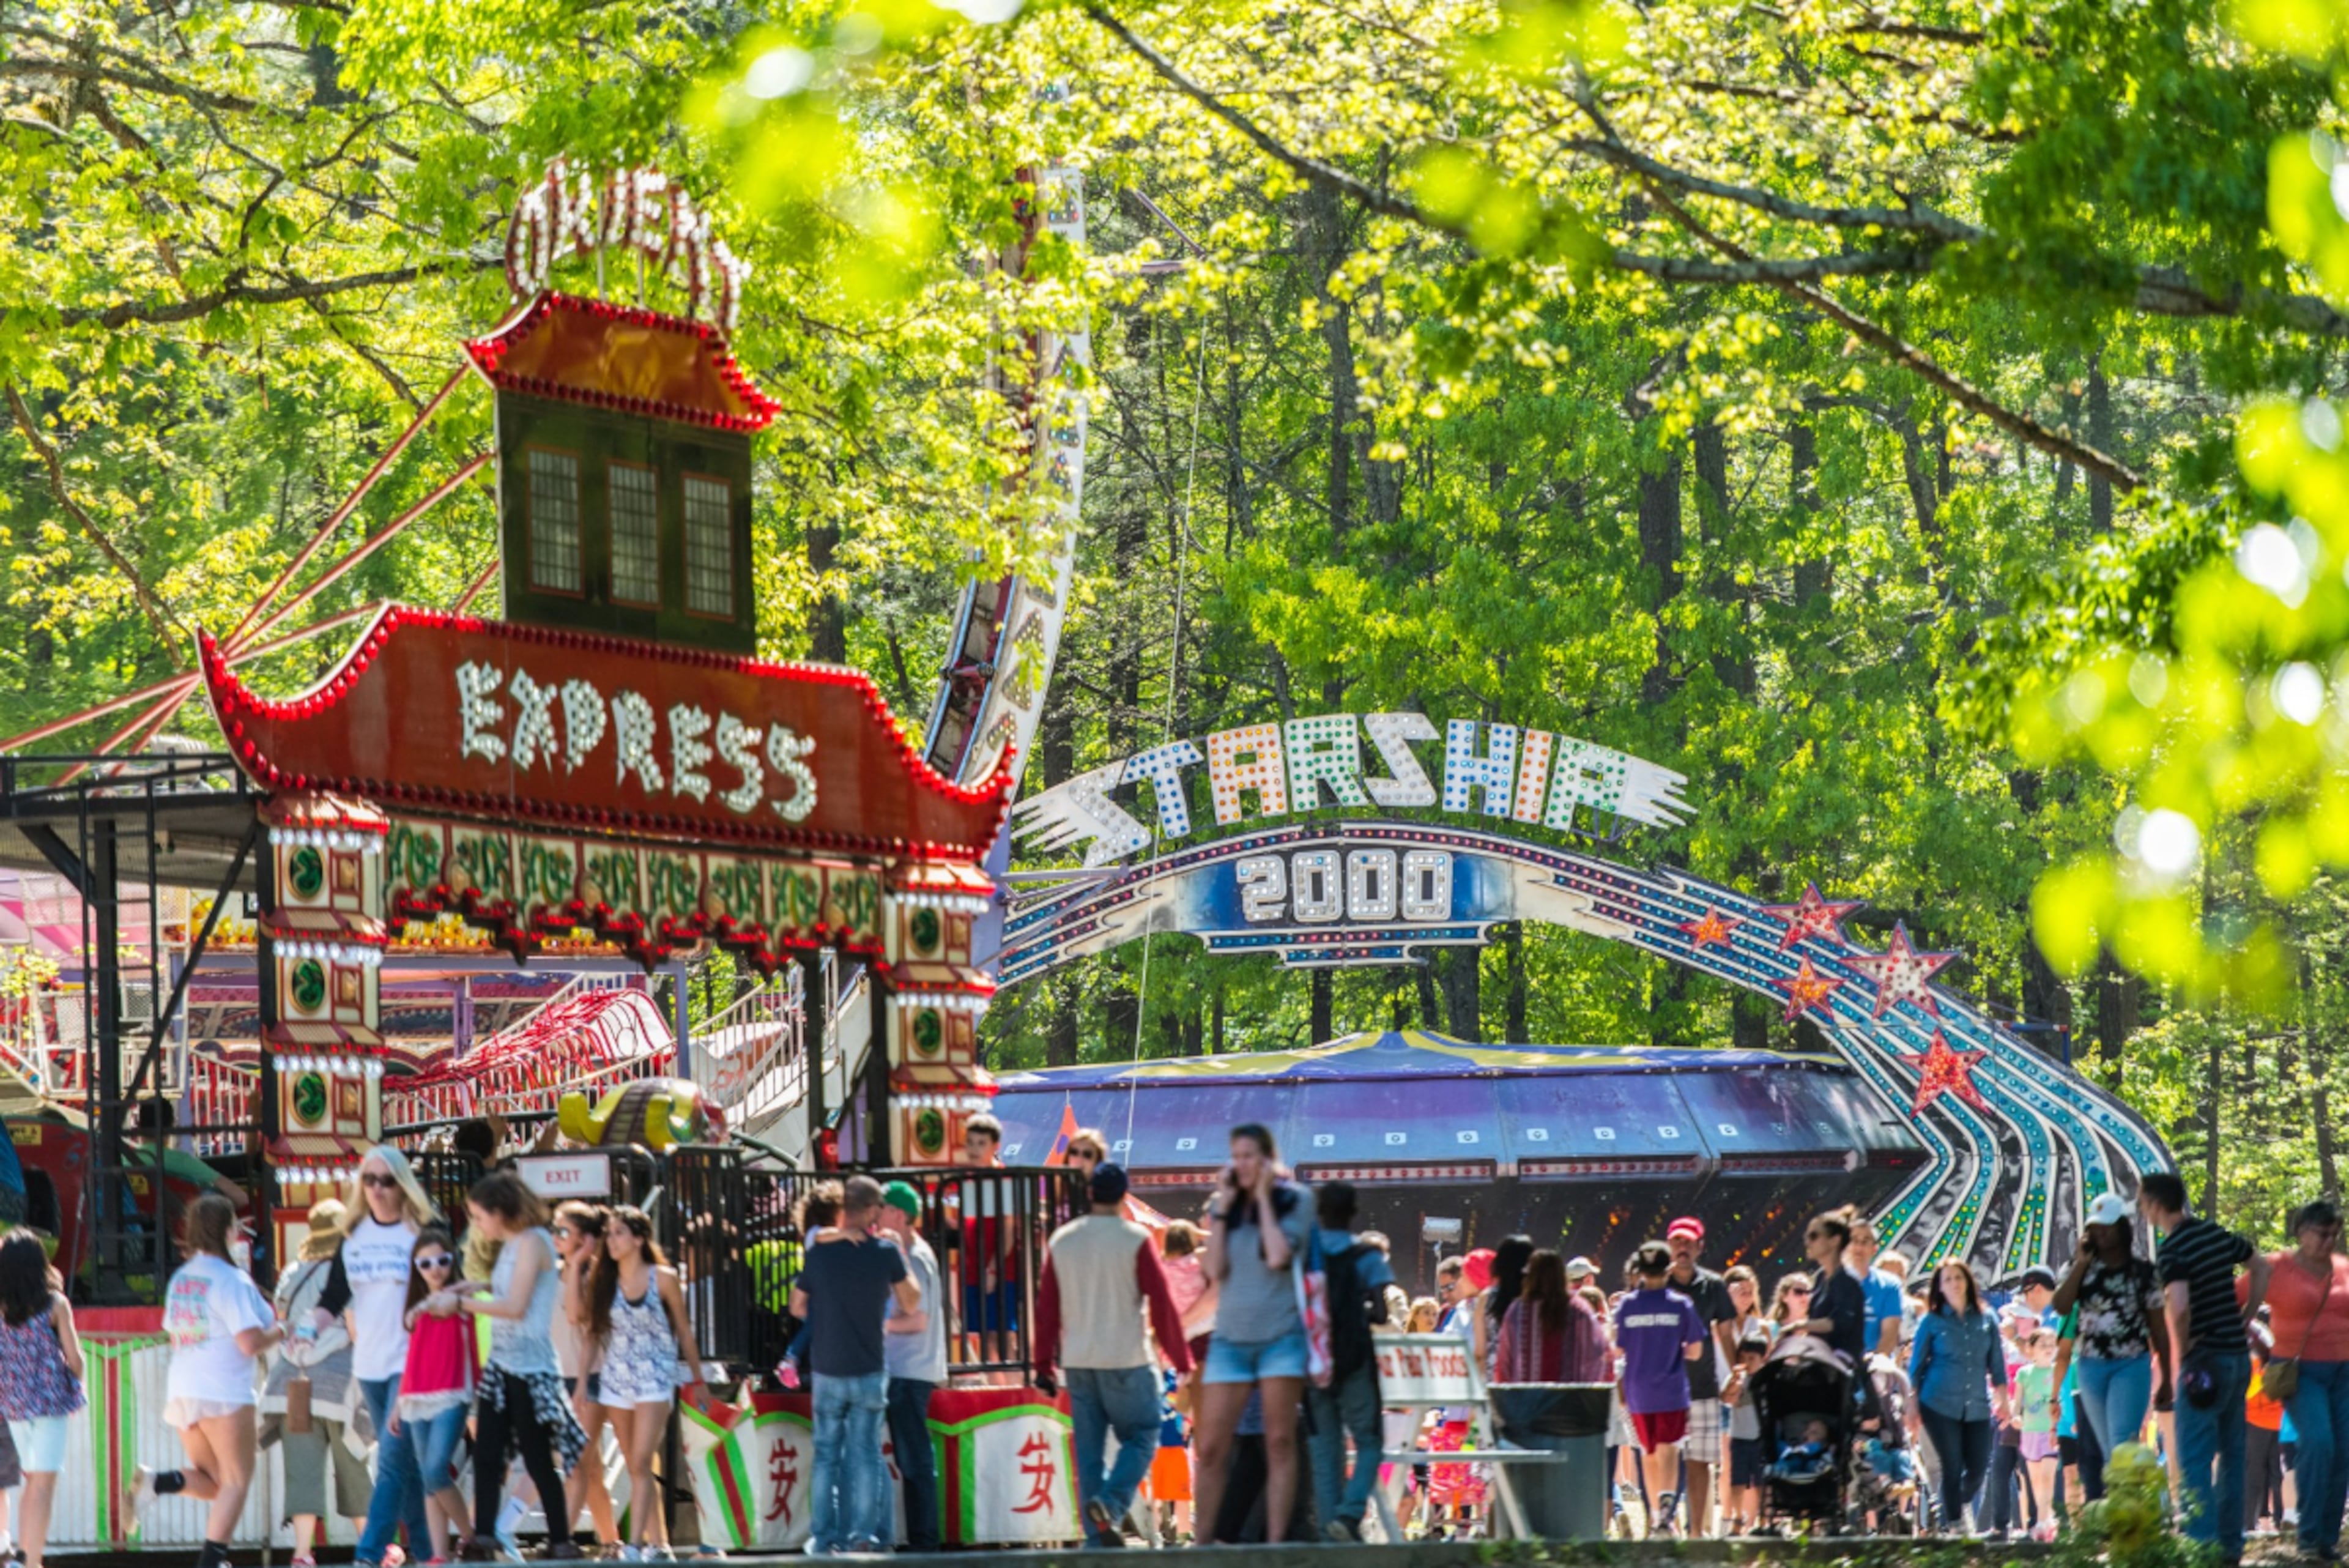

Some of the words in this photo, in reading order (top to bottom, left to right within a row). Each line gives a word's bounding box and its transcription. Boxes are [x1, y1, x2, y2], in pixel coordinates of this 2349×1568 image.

[455, 660, 817, 822] EXPRESS
[1011, 712, 1698, 868] STARSHIP
[1235, 849, 1453, 923] 2000
[544, 1169, 580, 1184] EXIT
[765, 1437, 798, 1529] 安
[1009, 1430, 1056, 1517] 安
